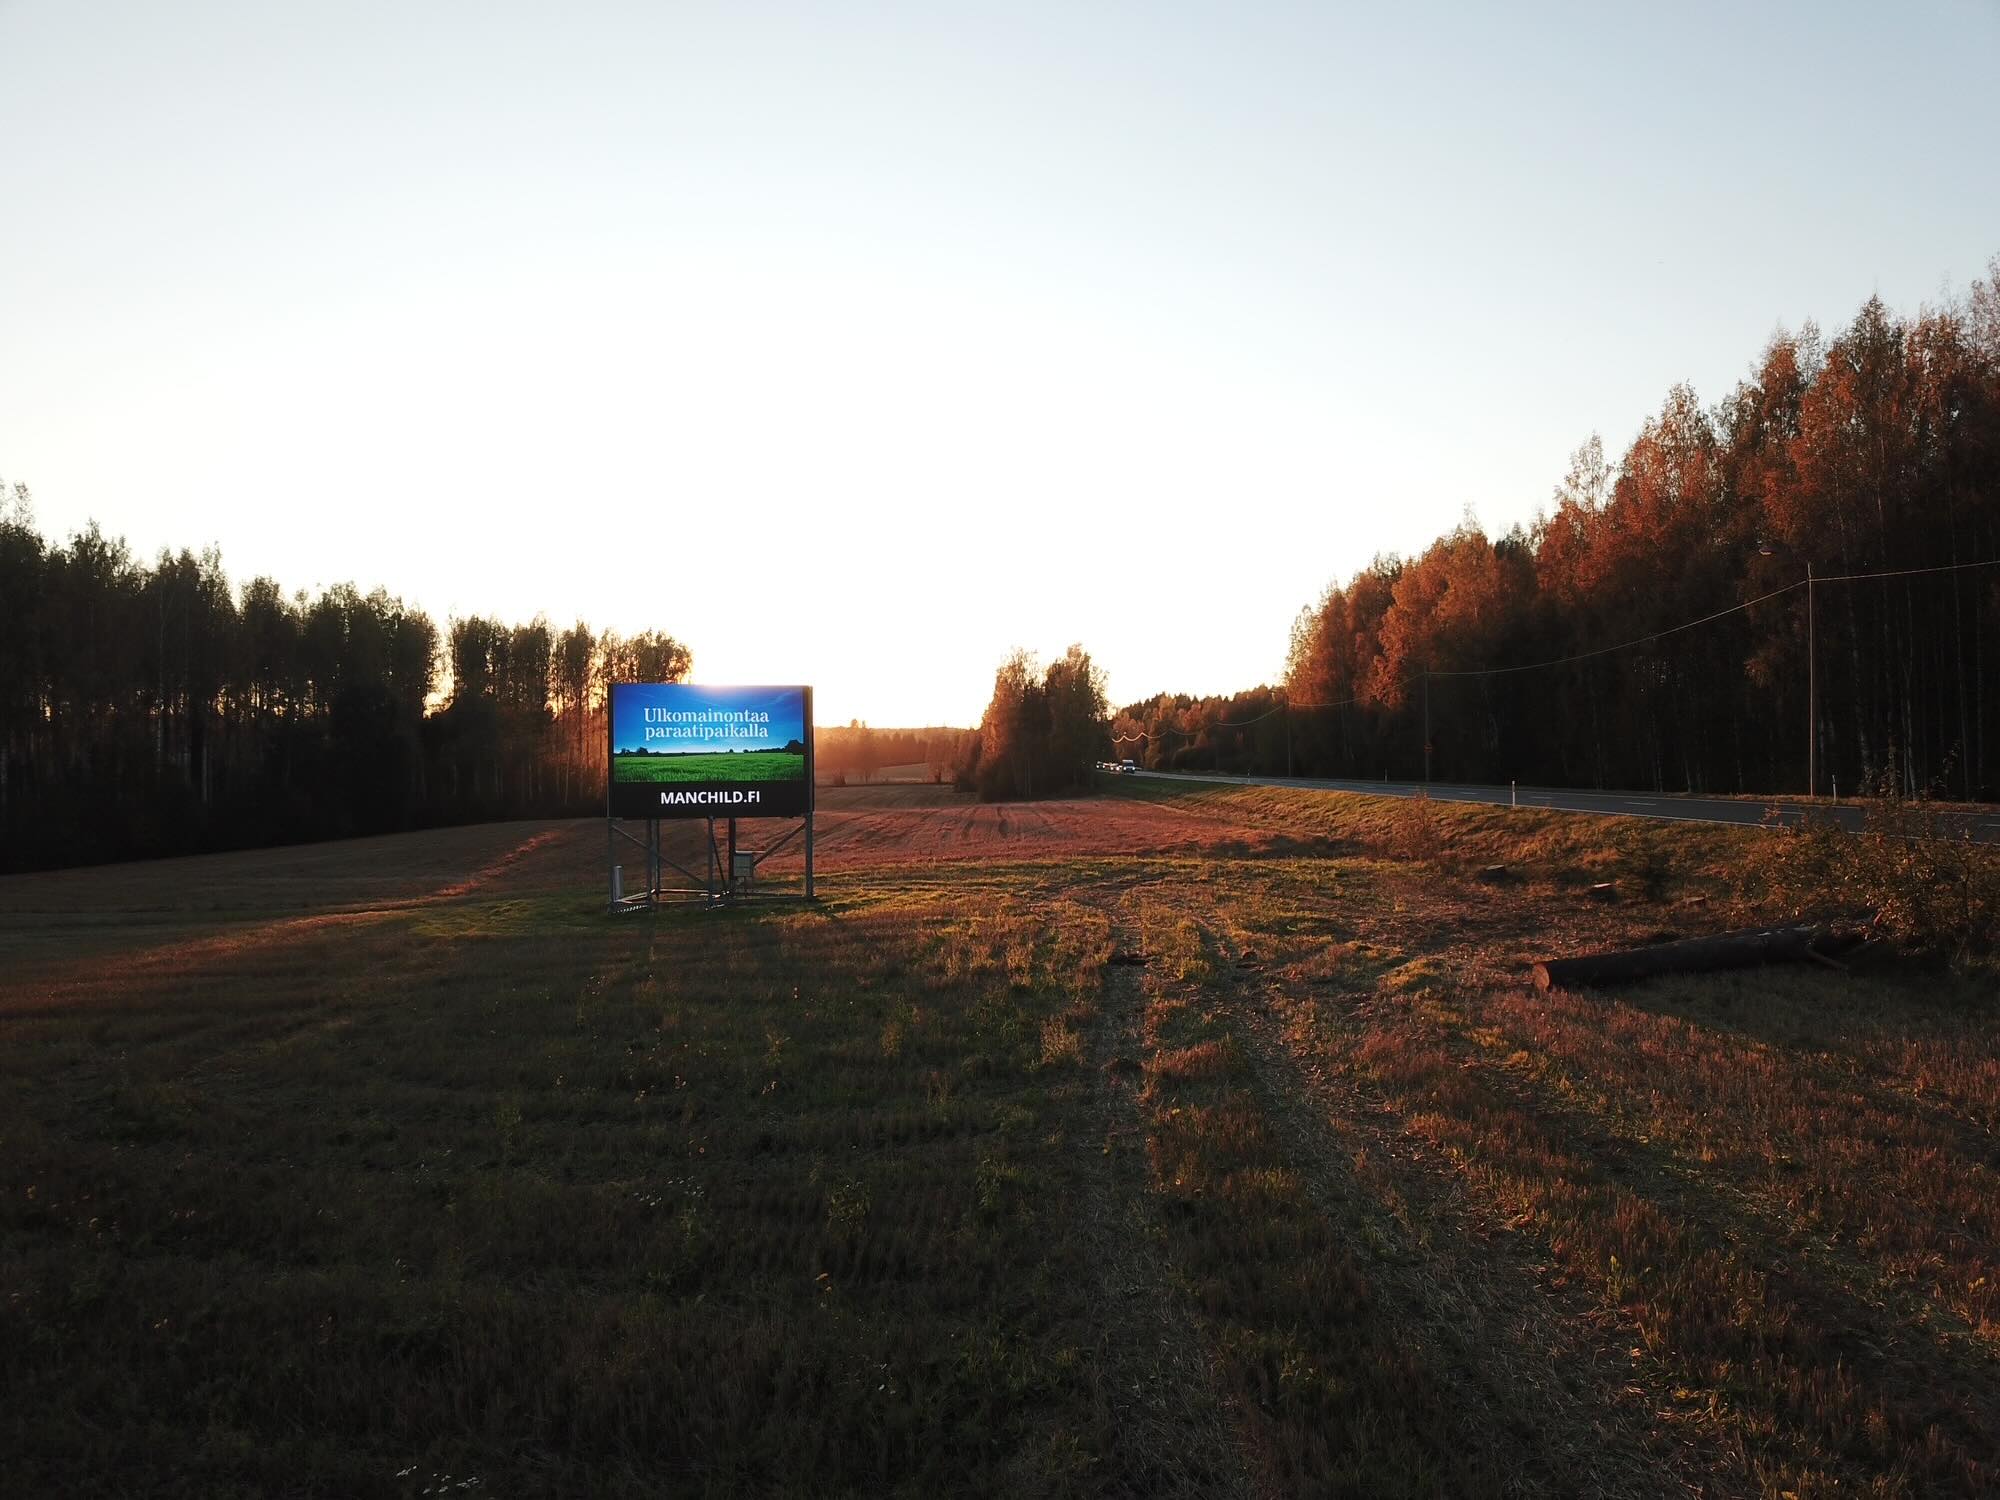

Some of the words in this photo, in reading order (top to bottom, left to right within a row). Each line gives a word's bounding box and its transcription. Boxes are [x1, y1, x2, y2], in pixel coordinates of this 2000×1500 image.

[644, 708, 769, 723] Ulkomainontaa
[645, 723, 769, 740] paraatipaikalla
[660, 790, 761, 805] MANCHILD.FI
